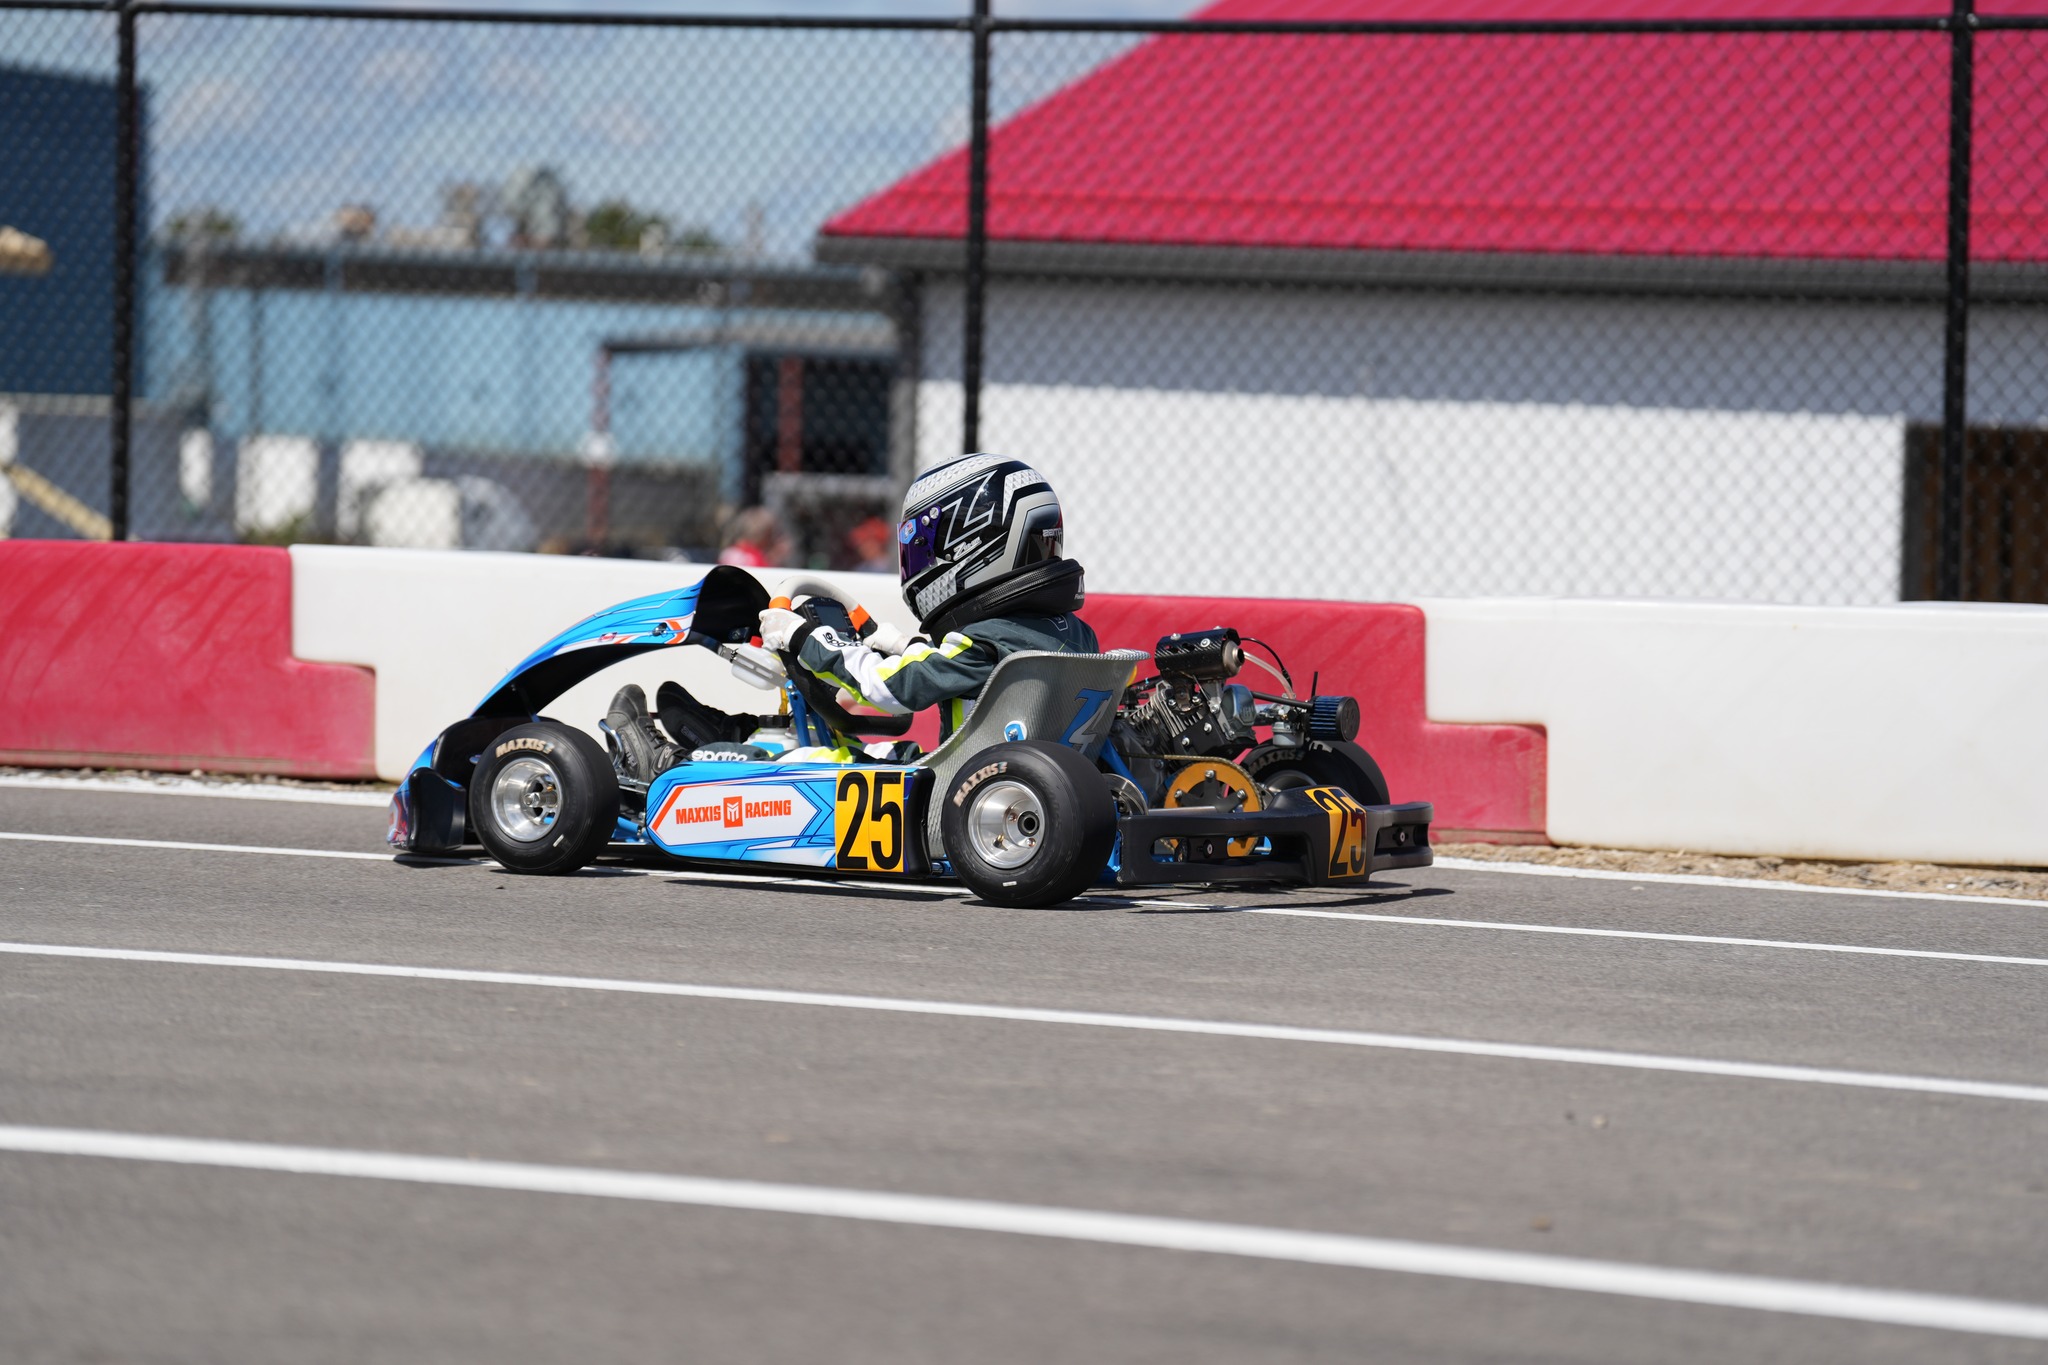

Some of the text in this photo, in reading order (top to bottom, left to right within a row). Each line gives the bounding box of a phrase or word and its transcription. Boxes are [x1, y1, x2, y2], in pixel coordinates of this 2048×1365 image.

[496, 738, 546, 758] MAXXIS
[676, 805, 721, 825] MAXXIS
[745, 800, 792, 818] RACING
[837, 771, 902, 870] 25
[1313, 788, 1366, 876] 25
